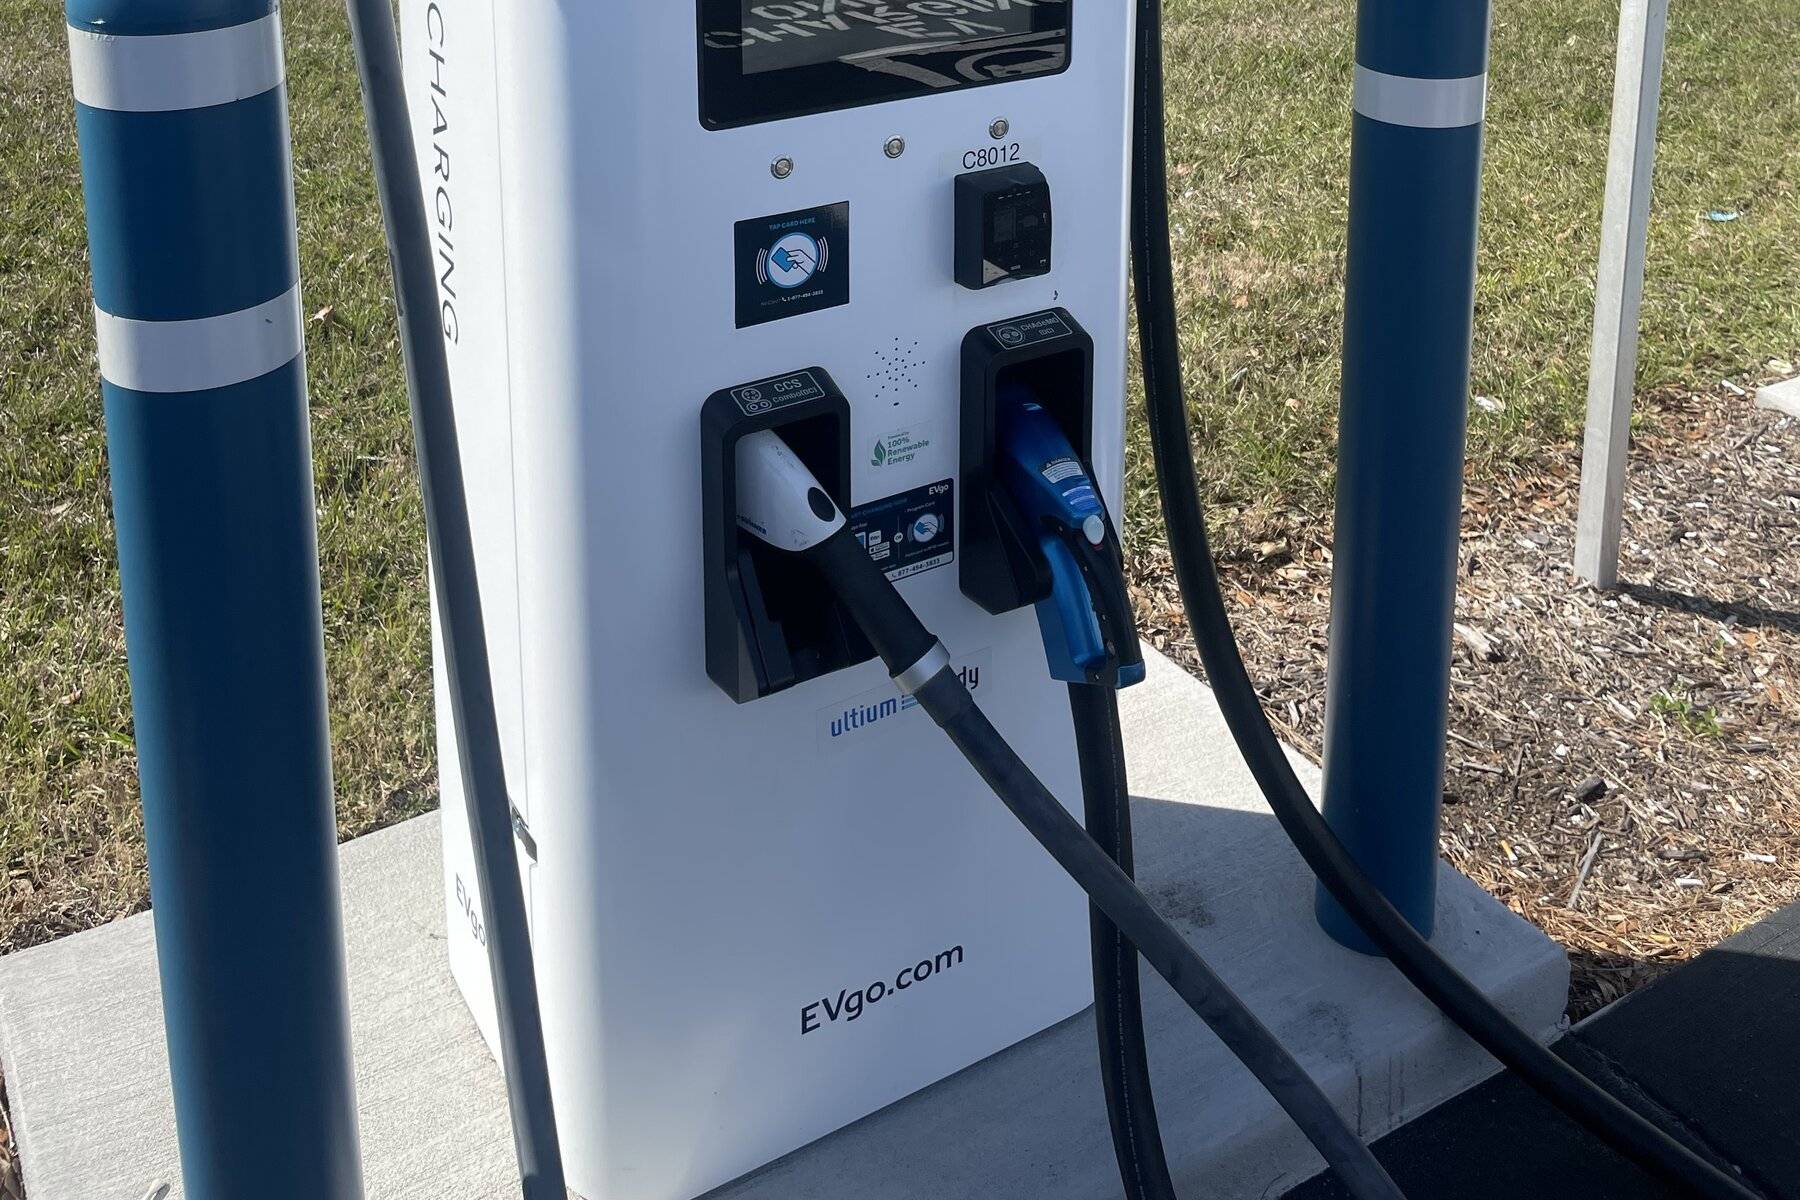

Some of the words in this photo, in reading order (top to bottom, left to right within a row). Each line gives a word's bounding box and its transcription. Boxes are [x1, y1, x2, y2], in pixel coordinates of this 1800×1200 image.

[962, 143, 1020, 169] C8012
[425, 2, 460, 348] CHARGING
[774, 378, 802, 392] CCS
[887, 437, 910, 449] 100%
[887, 439, 930, 457] Renewable
[887, 452, 915, 466] Energy
[928, 484, 949, 495] EVgo
[831, 697, 897, 737] ultium
[801, 944, 963, 1035] EVgo.com
